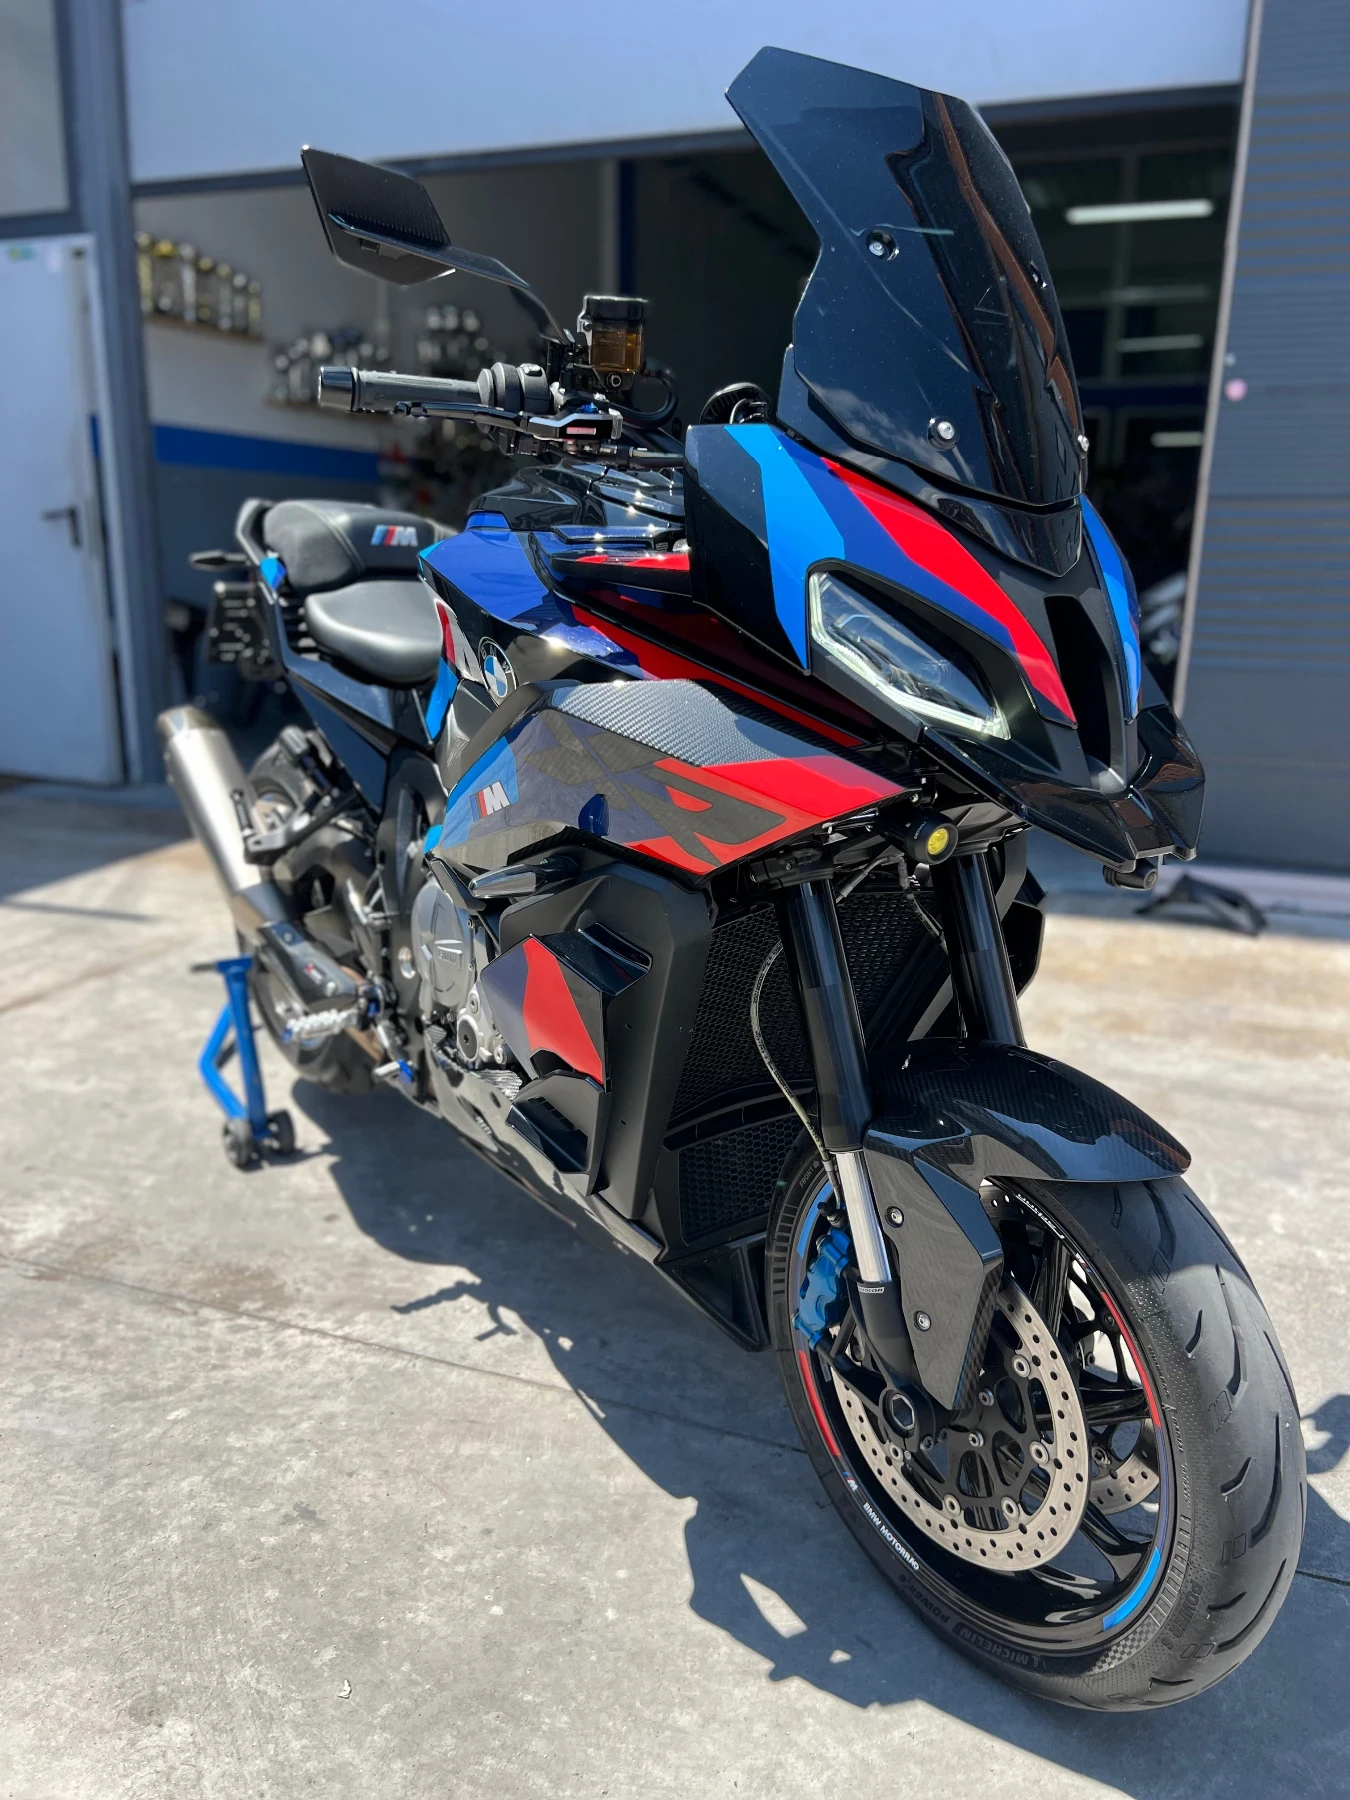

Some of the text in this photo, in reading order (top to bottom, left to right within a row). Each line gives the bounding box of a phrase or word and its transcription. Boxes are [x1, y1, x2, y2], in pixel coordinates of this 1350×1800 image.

[482, 780, 511, 816] M
[799, 1166, 815, 1188] FRONT
[863, 1502, 920, 1571] BMW MOTORRAD
[907, 1583, 951, 1625] POWER
[1167, 1579, 1204, 1639] POWER
[959, 1626, 1030, 1667] MICHELIN
